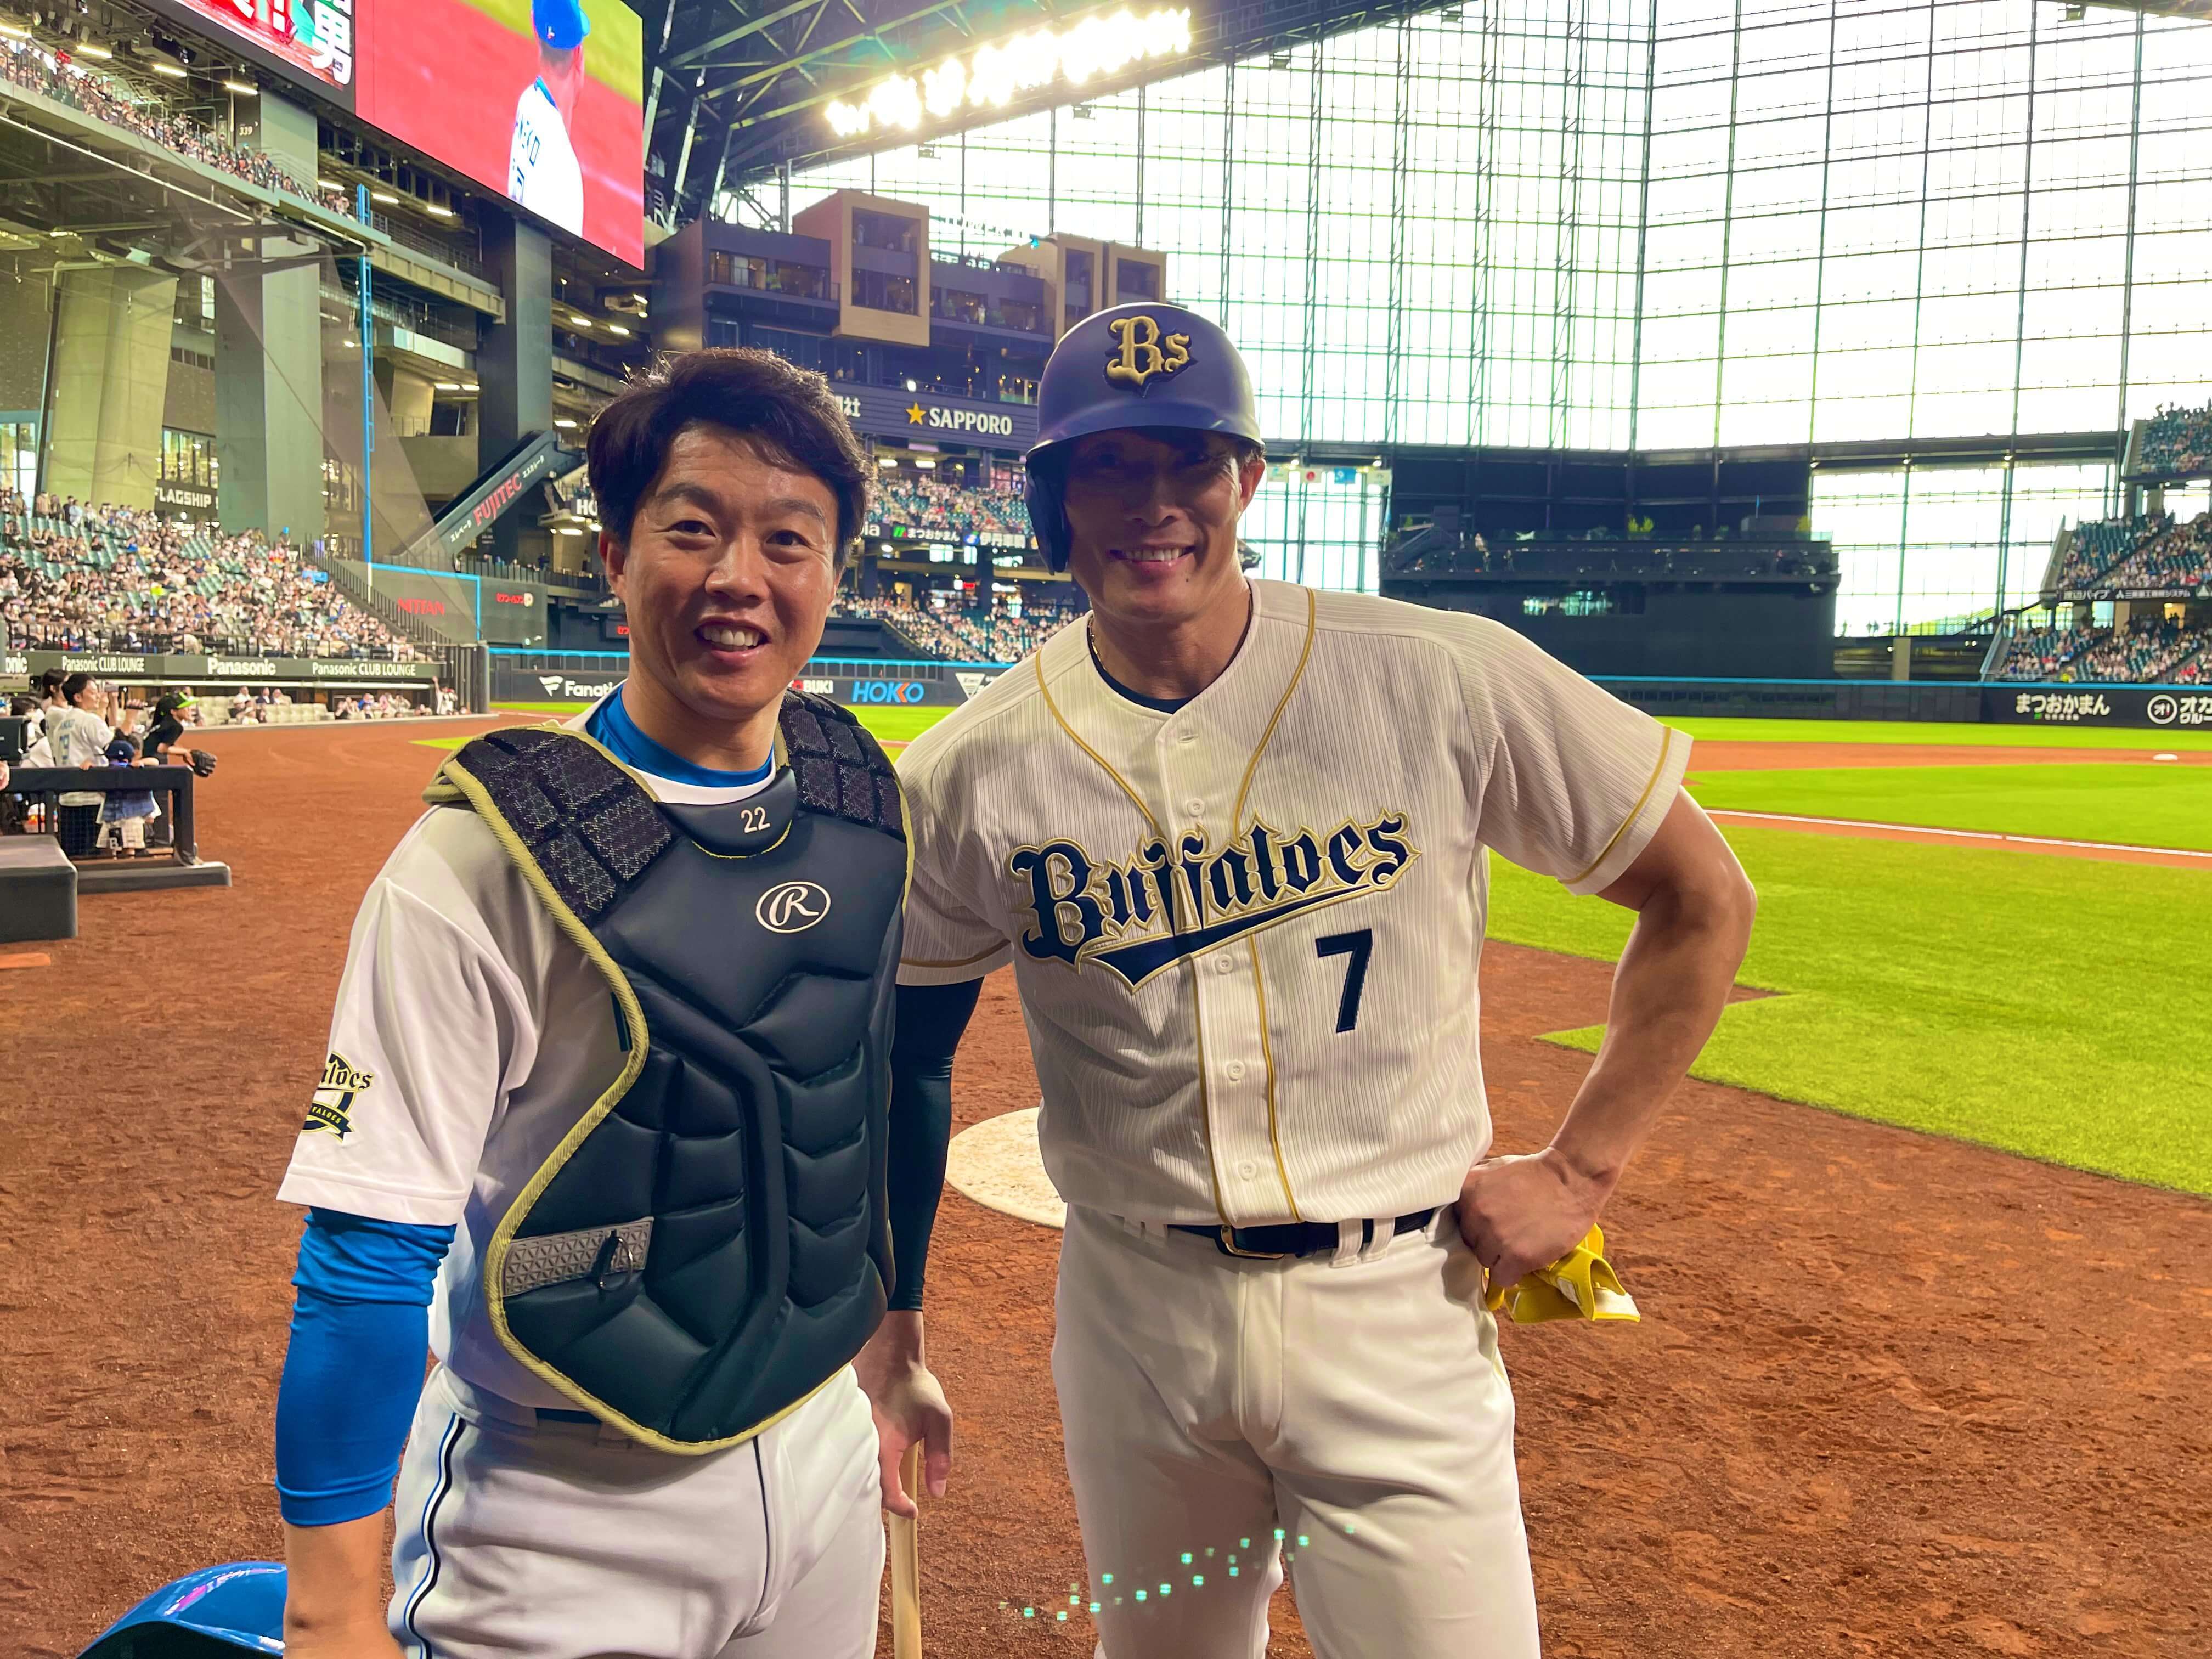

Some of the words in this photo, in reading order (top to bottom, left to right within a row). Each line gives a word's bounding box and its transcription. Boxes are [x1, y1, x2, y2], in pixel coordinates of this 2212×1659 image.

[308, 0, 352, 84] 男
[1106, 315, 1190, 385] Bs
[929, 407, 1012, 436] SAPPORO
[473, 473, 522, 527] FUJITEC
[907, 528, 960, 542] まつおかまん
[397, 596, 445, 616] NITTAN
[62, 655, 98, 672] Panasonic
[99, 657, 117, 672] CLUB
[118, 657, 145, 673] LOUNGE
[208, 657, 276, 675] Panasonic
[312, 662, 357, 675] Panasonic
[358, 663, 382, 676] CLUB
[382, 663, 416, 676] LOUNGE
[787, 680, 833, 694] OBUKI
[852, 680, 924, 703] HOKKO
[2016, 693, 2111, 716] まつおかまん
[741, 806, 770, 833] 22
[1005, 808, 1423, 974] Buffaloes
[1315, 928, 1373, 1034] 7
